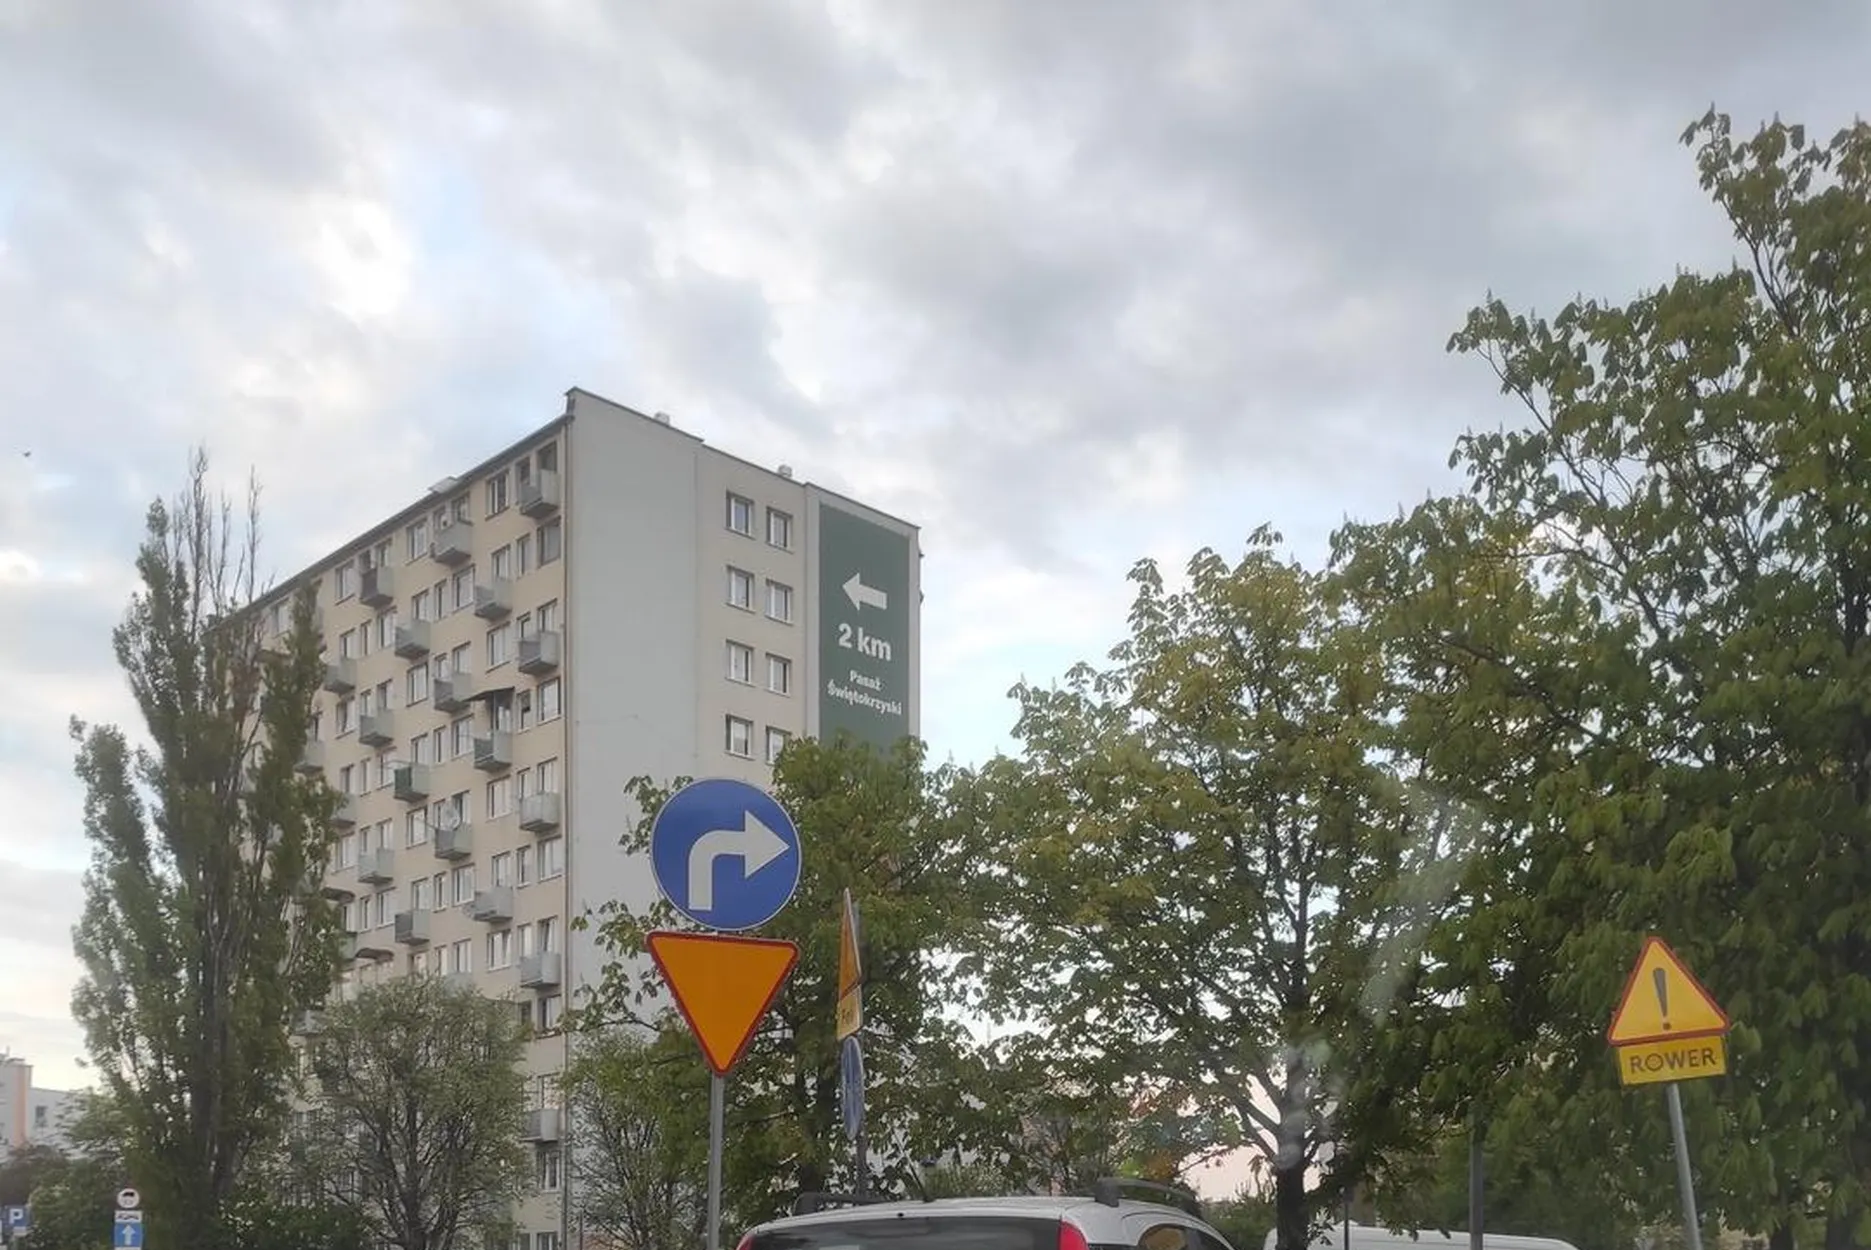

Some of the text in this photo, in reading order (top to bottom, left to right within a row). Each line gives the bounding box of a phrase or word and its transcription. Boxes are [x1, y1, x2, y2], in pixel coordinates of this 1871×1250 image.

[838, 623, 891, 661] 2 km
[850, 670, 880, 691] Pasaż
[827, 679, 902, 715] Świętokrzyski
[1629, 1047, 1716, 1074] ROWER
[9, 1208, 23, 1224] P
